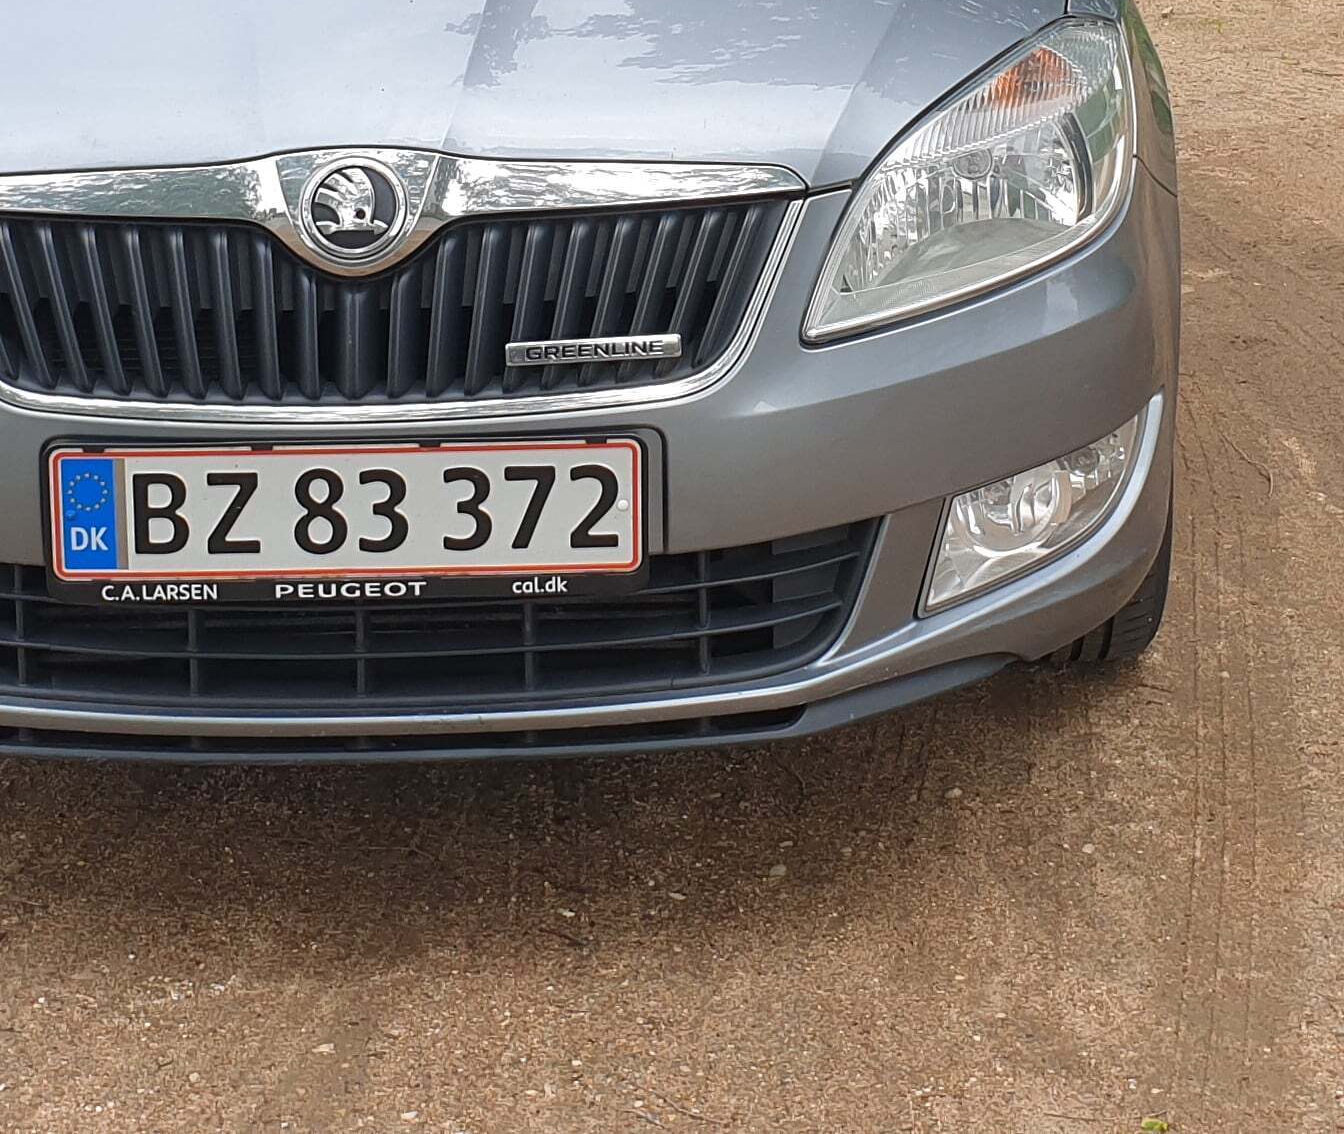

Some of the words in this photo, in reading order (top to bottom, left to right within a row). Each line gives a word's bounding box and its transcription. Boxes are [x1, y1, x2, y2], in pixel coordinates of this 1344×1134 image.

[525, 340, 664, 361] GREENLINE
[132, 472, 261, 554] BZ
[294, 468, 409, 555] 83
[443, 464, 619, 551] 372
[70, 526, 108, 551] DK
[274, 581, 427, 599] PEUGEOT
[511, 577, 568, 594] cal.dk
